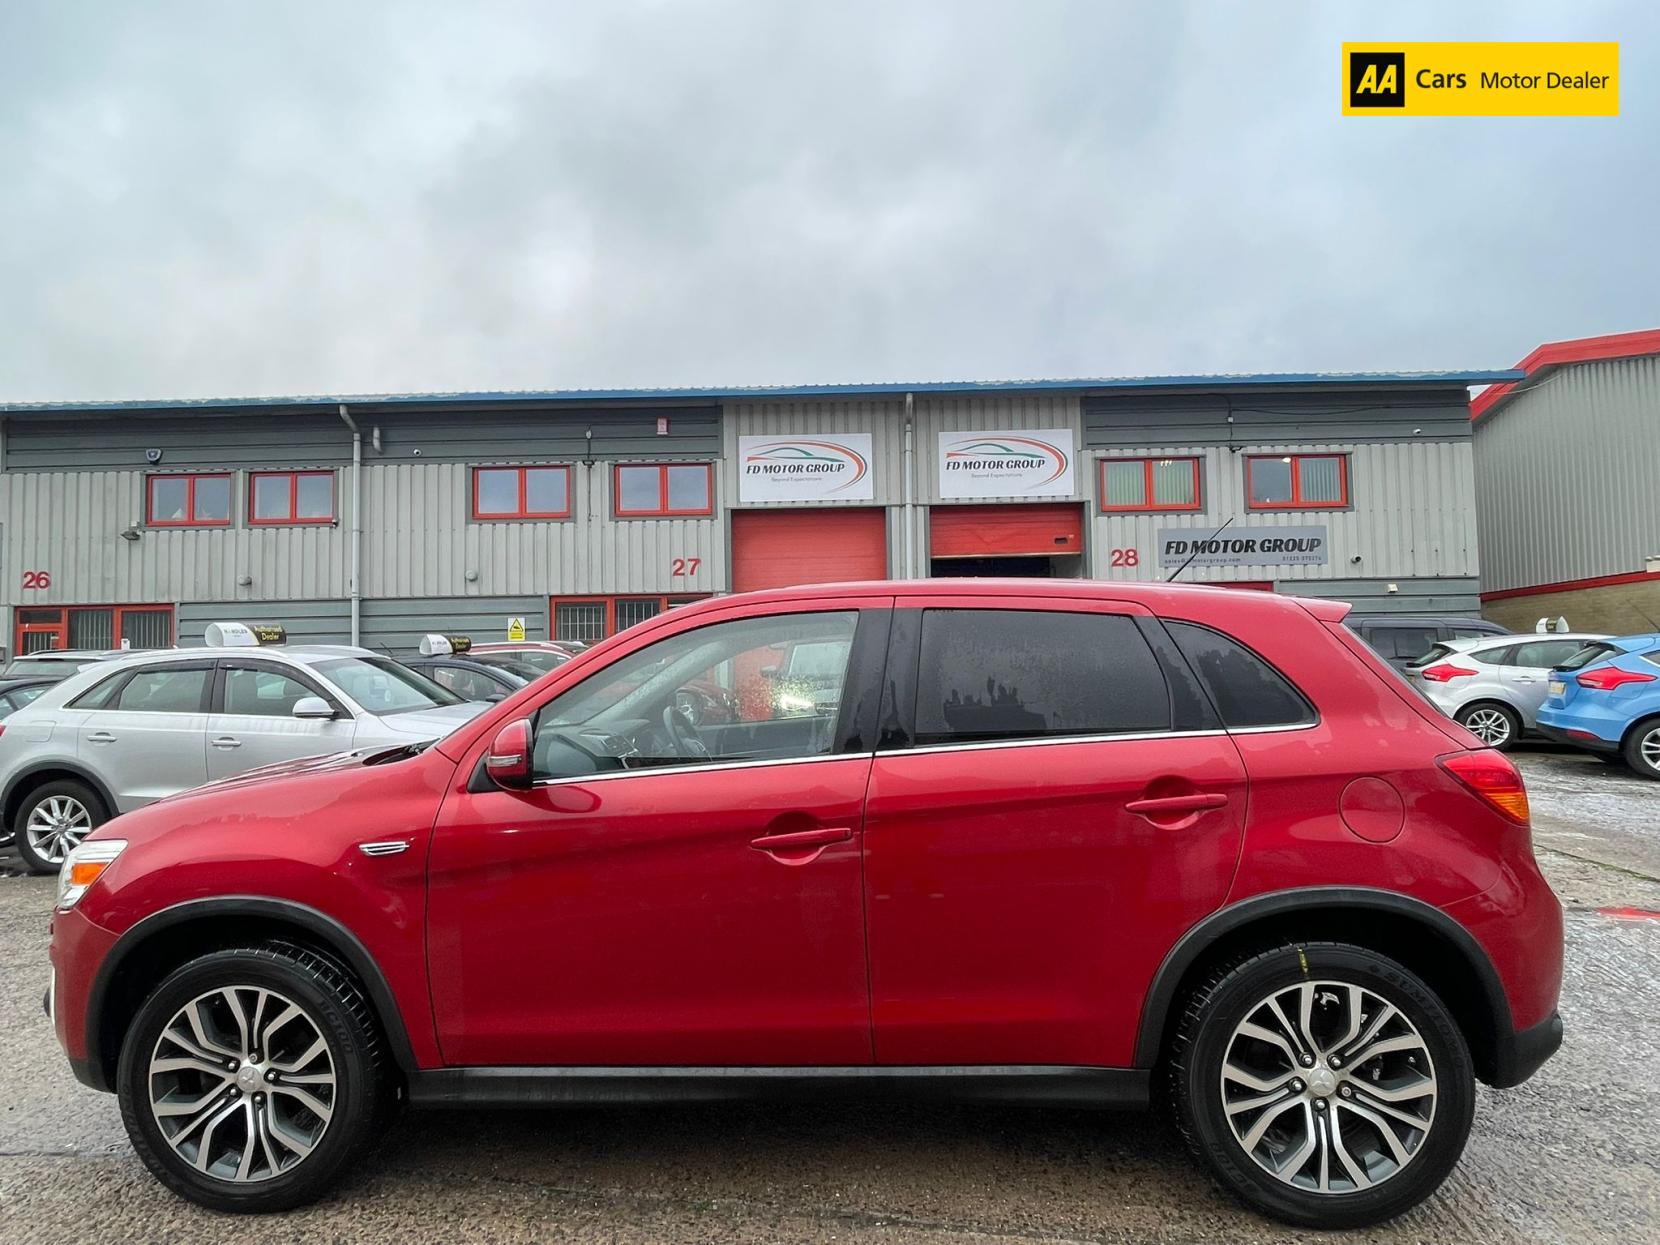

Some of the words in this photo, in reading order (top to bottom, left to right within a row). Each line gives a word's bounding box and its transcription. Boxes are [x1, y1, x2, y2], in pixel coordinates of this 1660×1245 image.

[746, 465, 760, 475] FD
[762, 464, 803, 474] MOTOR
[806, 463, 845, 473] GROUP
[946, 461, 960, 471] FD
[962, 460, 1003, 470] MOTOR
[1006, 458, 1045, 469] GROUP
[1164, 541, 1188, 555] FD
[1190, 539, 1257, 554] MOTOR
[1259, 538, 1322, 553] GROUP
[1111, 549, 1139, 567] 28
[672, 558, 702, 576] 27
[23, 571, 51, 589] 26
